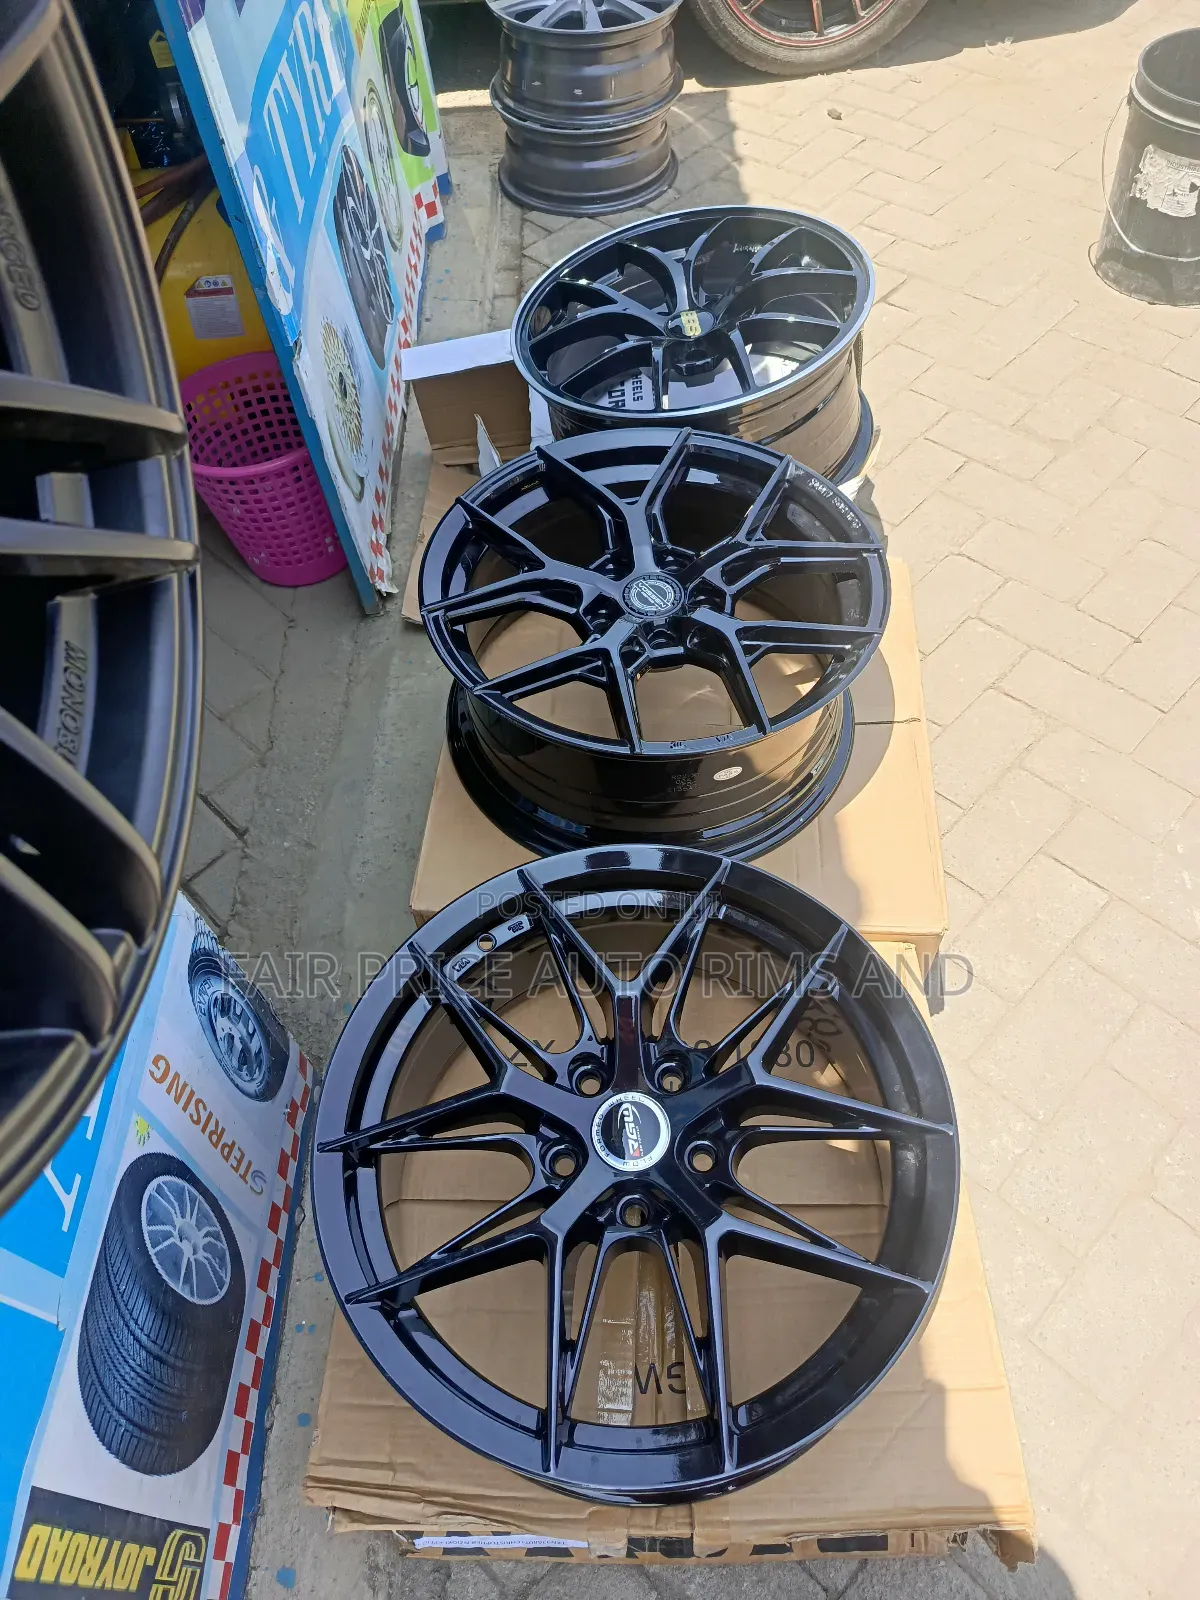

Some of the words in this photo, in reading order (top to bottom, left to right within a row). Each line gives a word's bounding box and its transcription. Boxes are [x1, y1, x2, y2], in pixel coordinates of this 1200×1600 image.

[680, 310, 702, 337] BBS
[149, 1053, 267, 1196] STEPRISING
[595, 1113, 610, 1158] FORMED
[14, 1524, 157, 1594] JOYROAD
